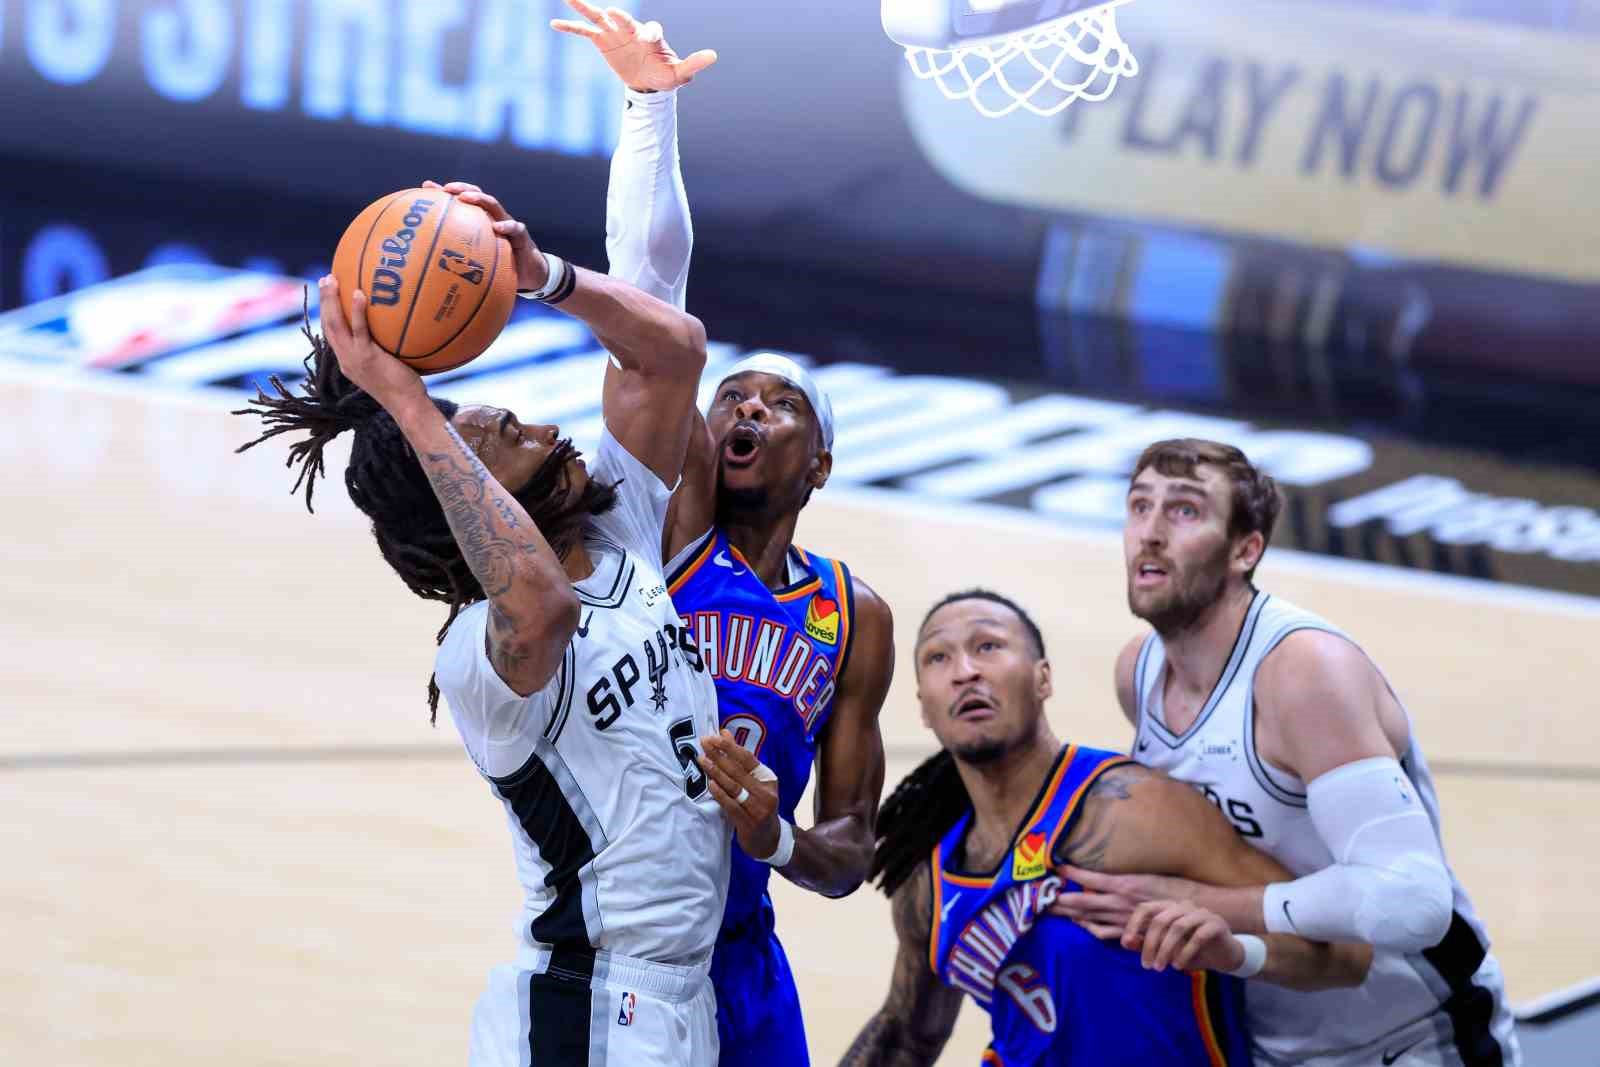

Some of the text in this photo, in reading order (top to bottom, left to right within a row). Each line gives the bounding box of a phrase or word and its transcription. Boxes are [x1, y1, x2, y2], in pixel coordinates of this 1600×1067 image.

[1303, 70, 1537, 201] NOW
[370, 198, 434, 306] Wilson
[680, 611, 837, 732] HUNDER
[667, 714, 710, 801] 5
[997, 963, 1057, 1034] 6
